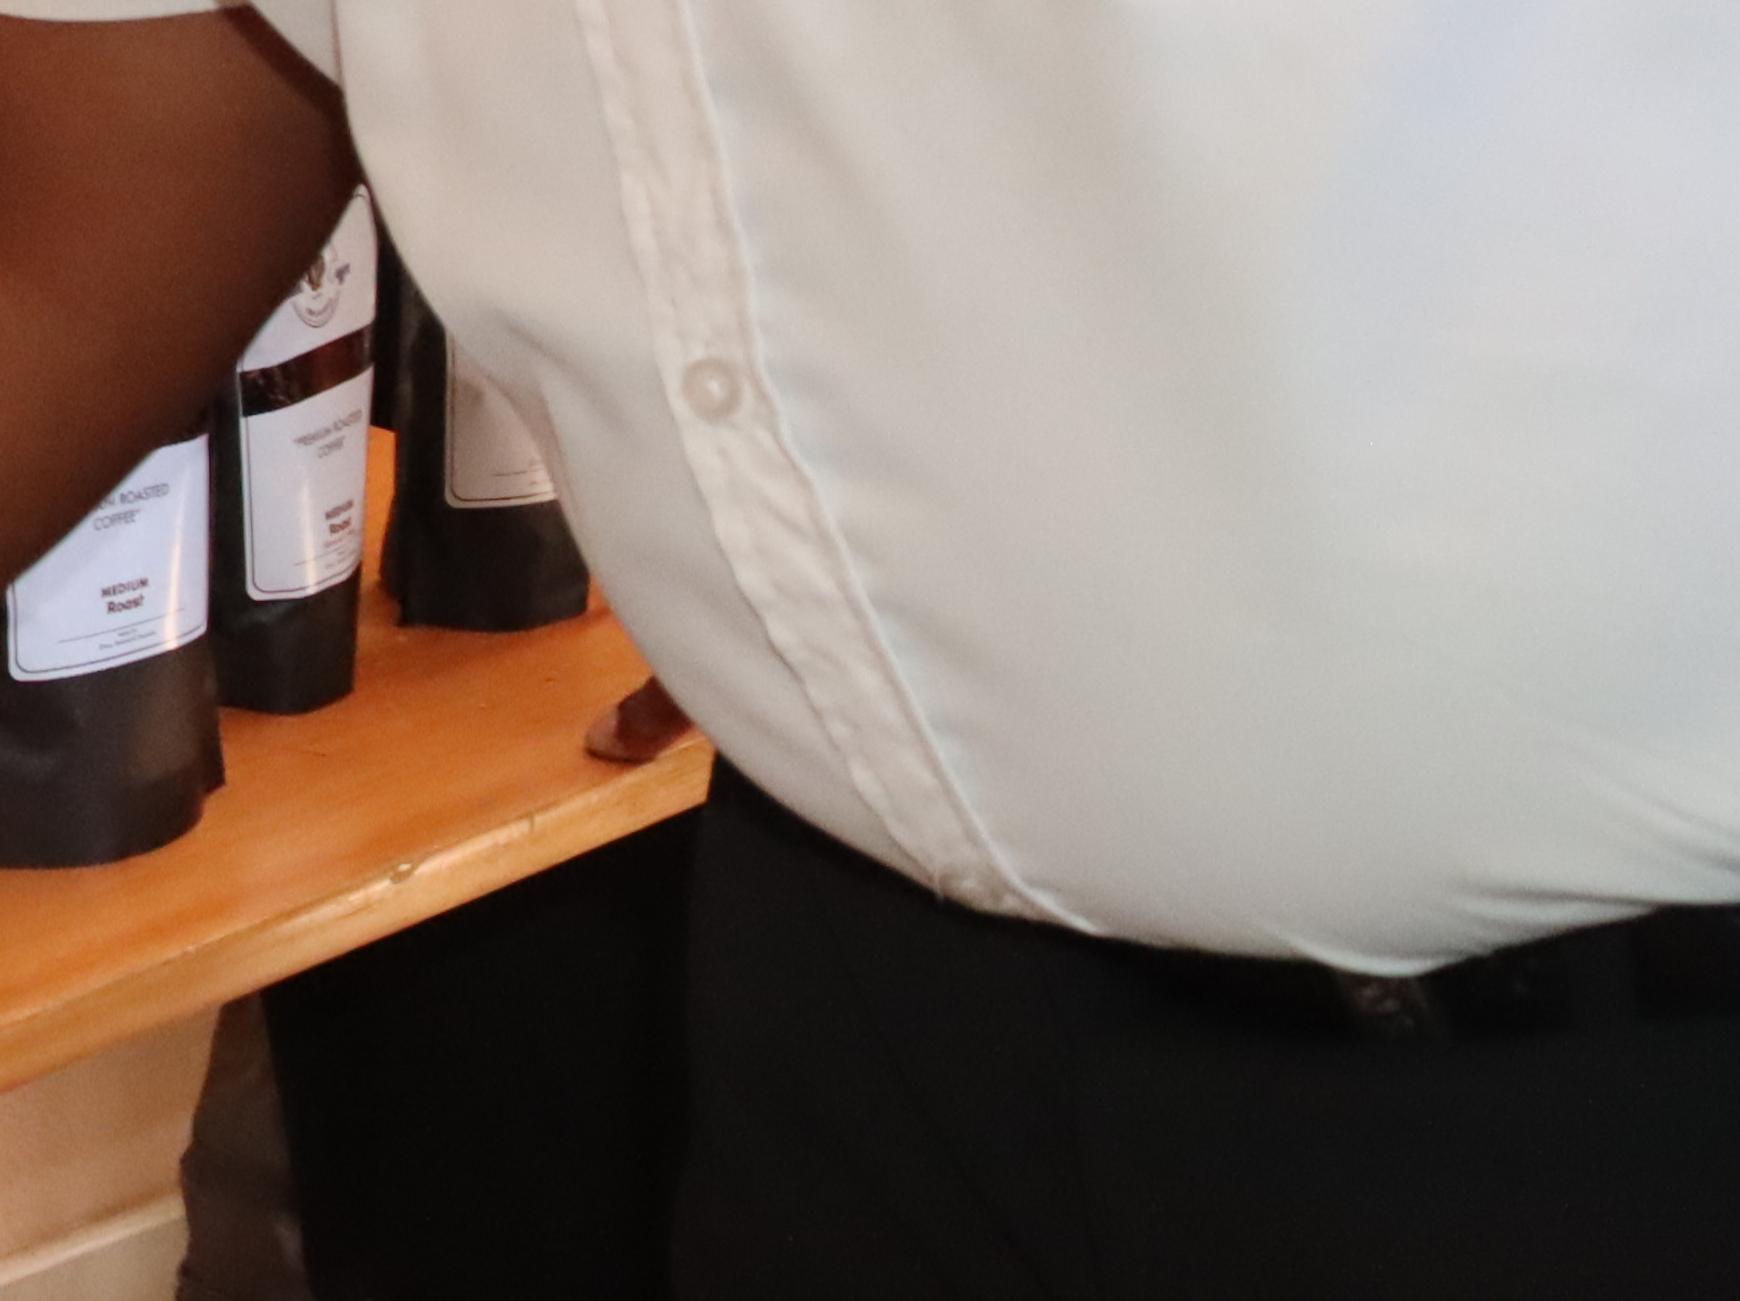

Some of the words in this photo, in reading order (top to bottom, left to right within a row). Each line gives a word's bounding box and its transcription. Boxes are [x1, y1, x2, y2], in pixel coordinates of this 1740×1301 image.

[119, 482, 171, 505] ROASTED
[100, 577, 149, 598] MEDIUM
[106, 593, 145, 615] Roast
